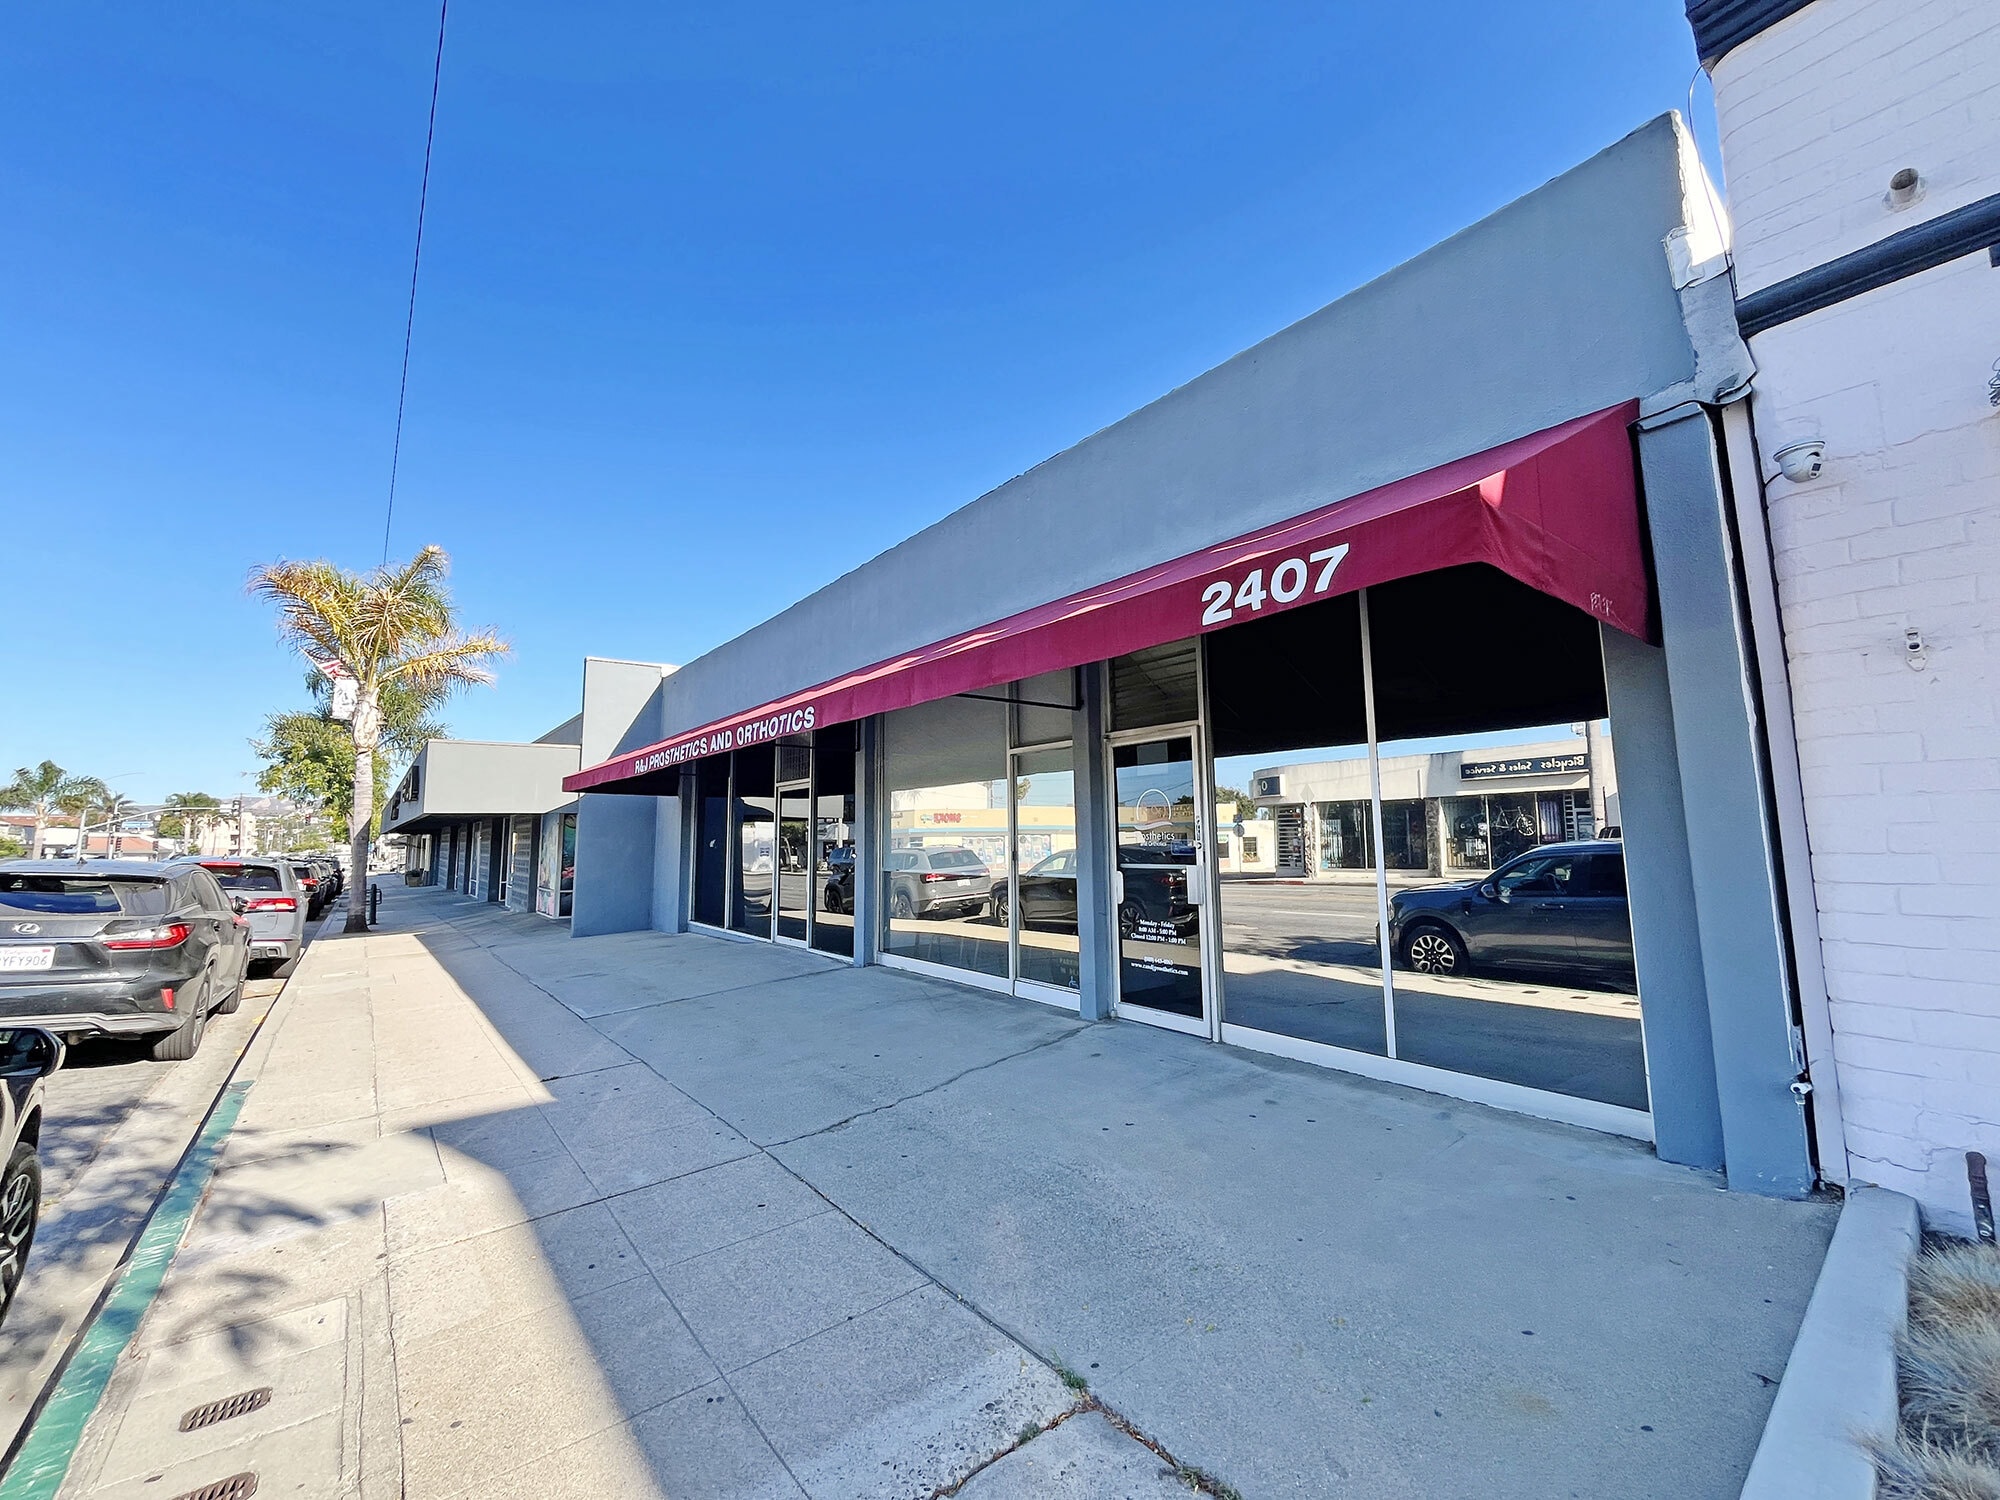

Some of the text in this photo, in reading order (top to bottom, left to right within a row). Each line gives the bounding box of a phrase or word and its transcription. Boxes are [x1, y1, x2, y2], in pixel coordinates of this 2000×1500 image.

[1201, 542, 1350, 626] 2407
[634, 705, 816, 775] R&J PROSTHETICS AND ORTHOTICS
[0, 955, 48, 967] YFY906
